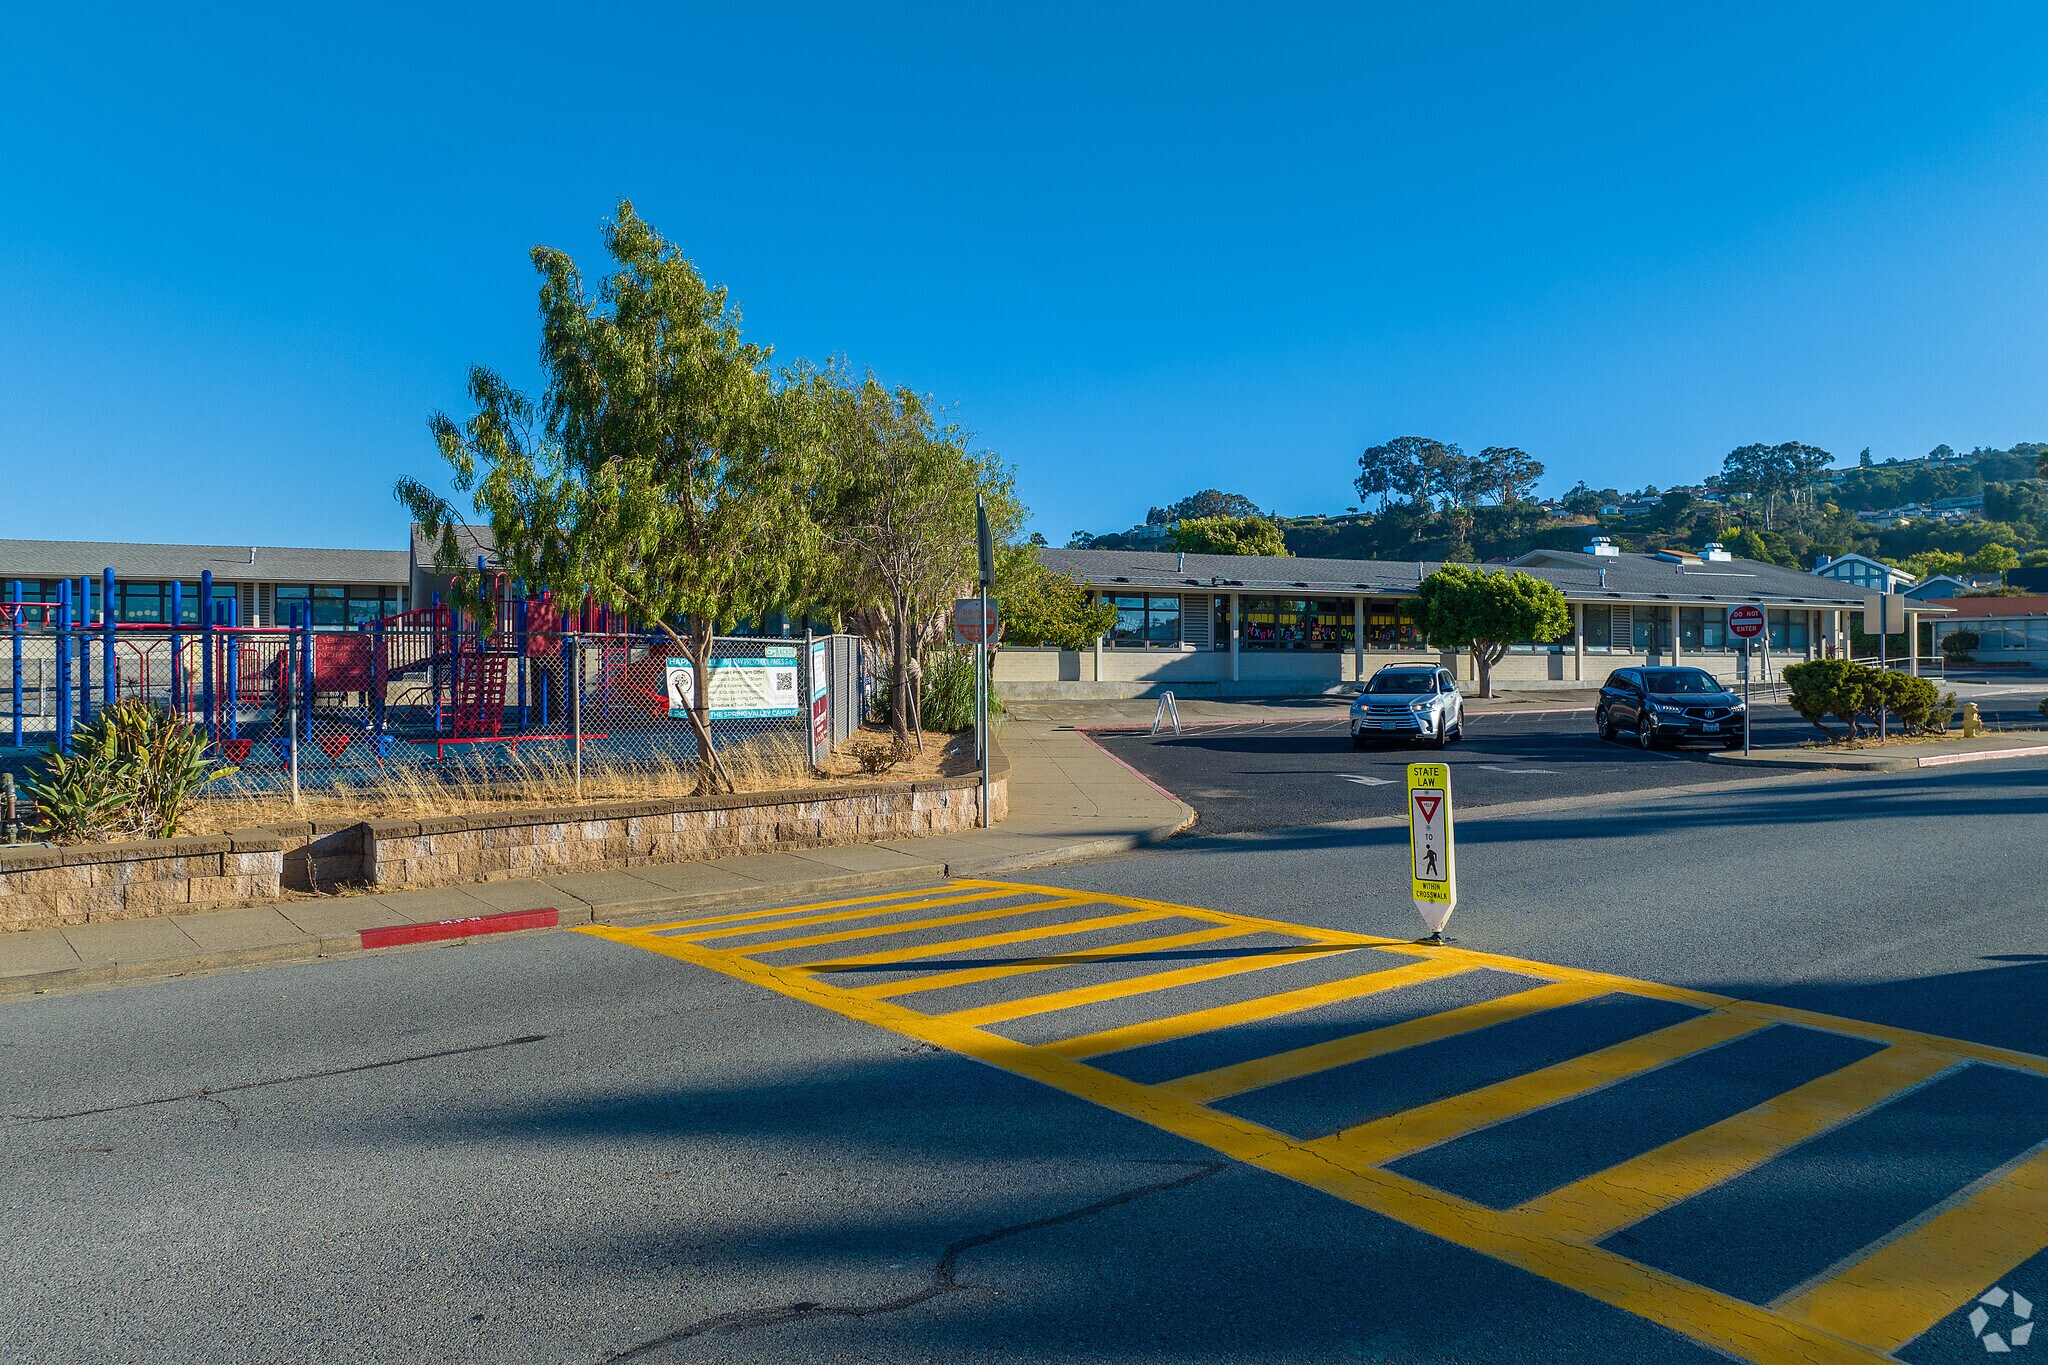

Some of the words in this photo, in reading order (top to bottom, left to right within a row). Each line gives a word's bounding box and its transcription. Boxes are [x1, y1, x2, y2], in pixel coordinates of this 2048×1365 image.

[723, 710, 747, 718] SPRING
[1413, 767, 1439, 776] STATE
[1417, 778, 1435, 787] LAW
[1421, 882, 1441, 890] WITHIN
[1416, 890, 1448, 900] CROSSWALK
